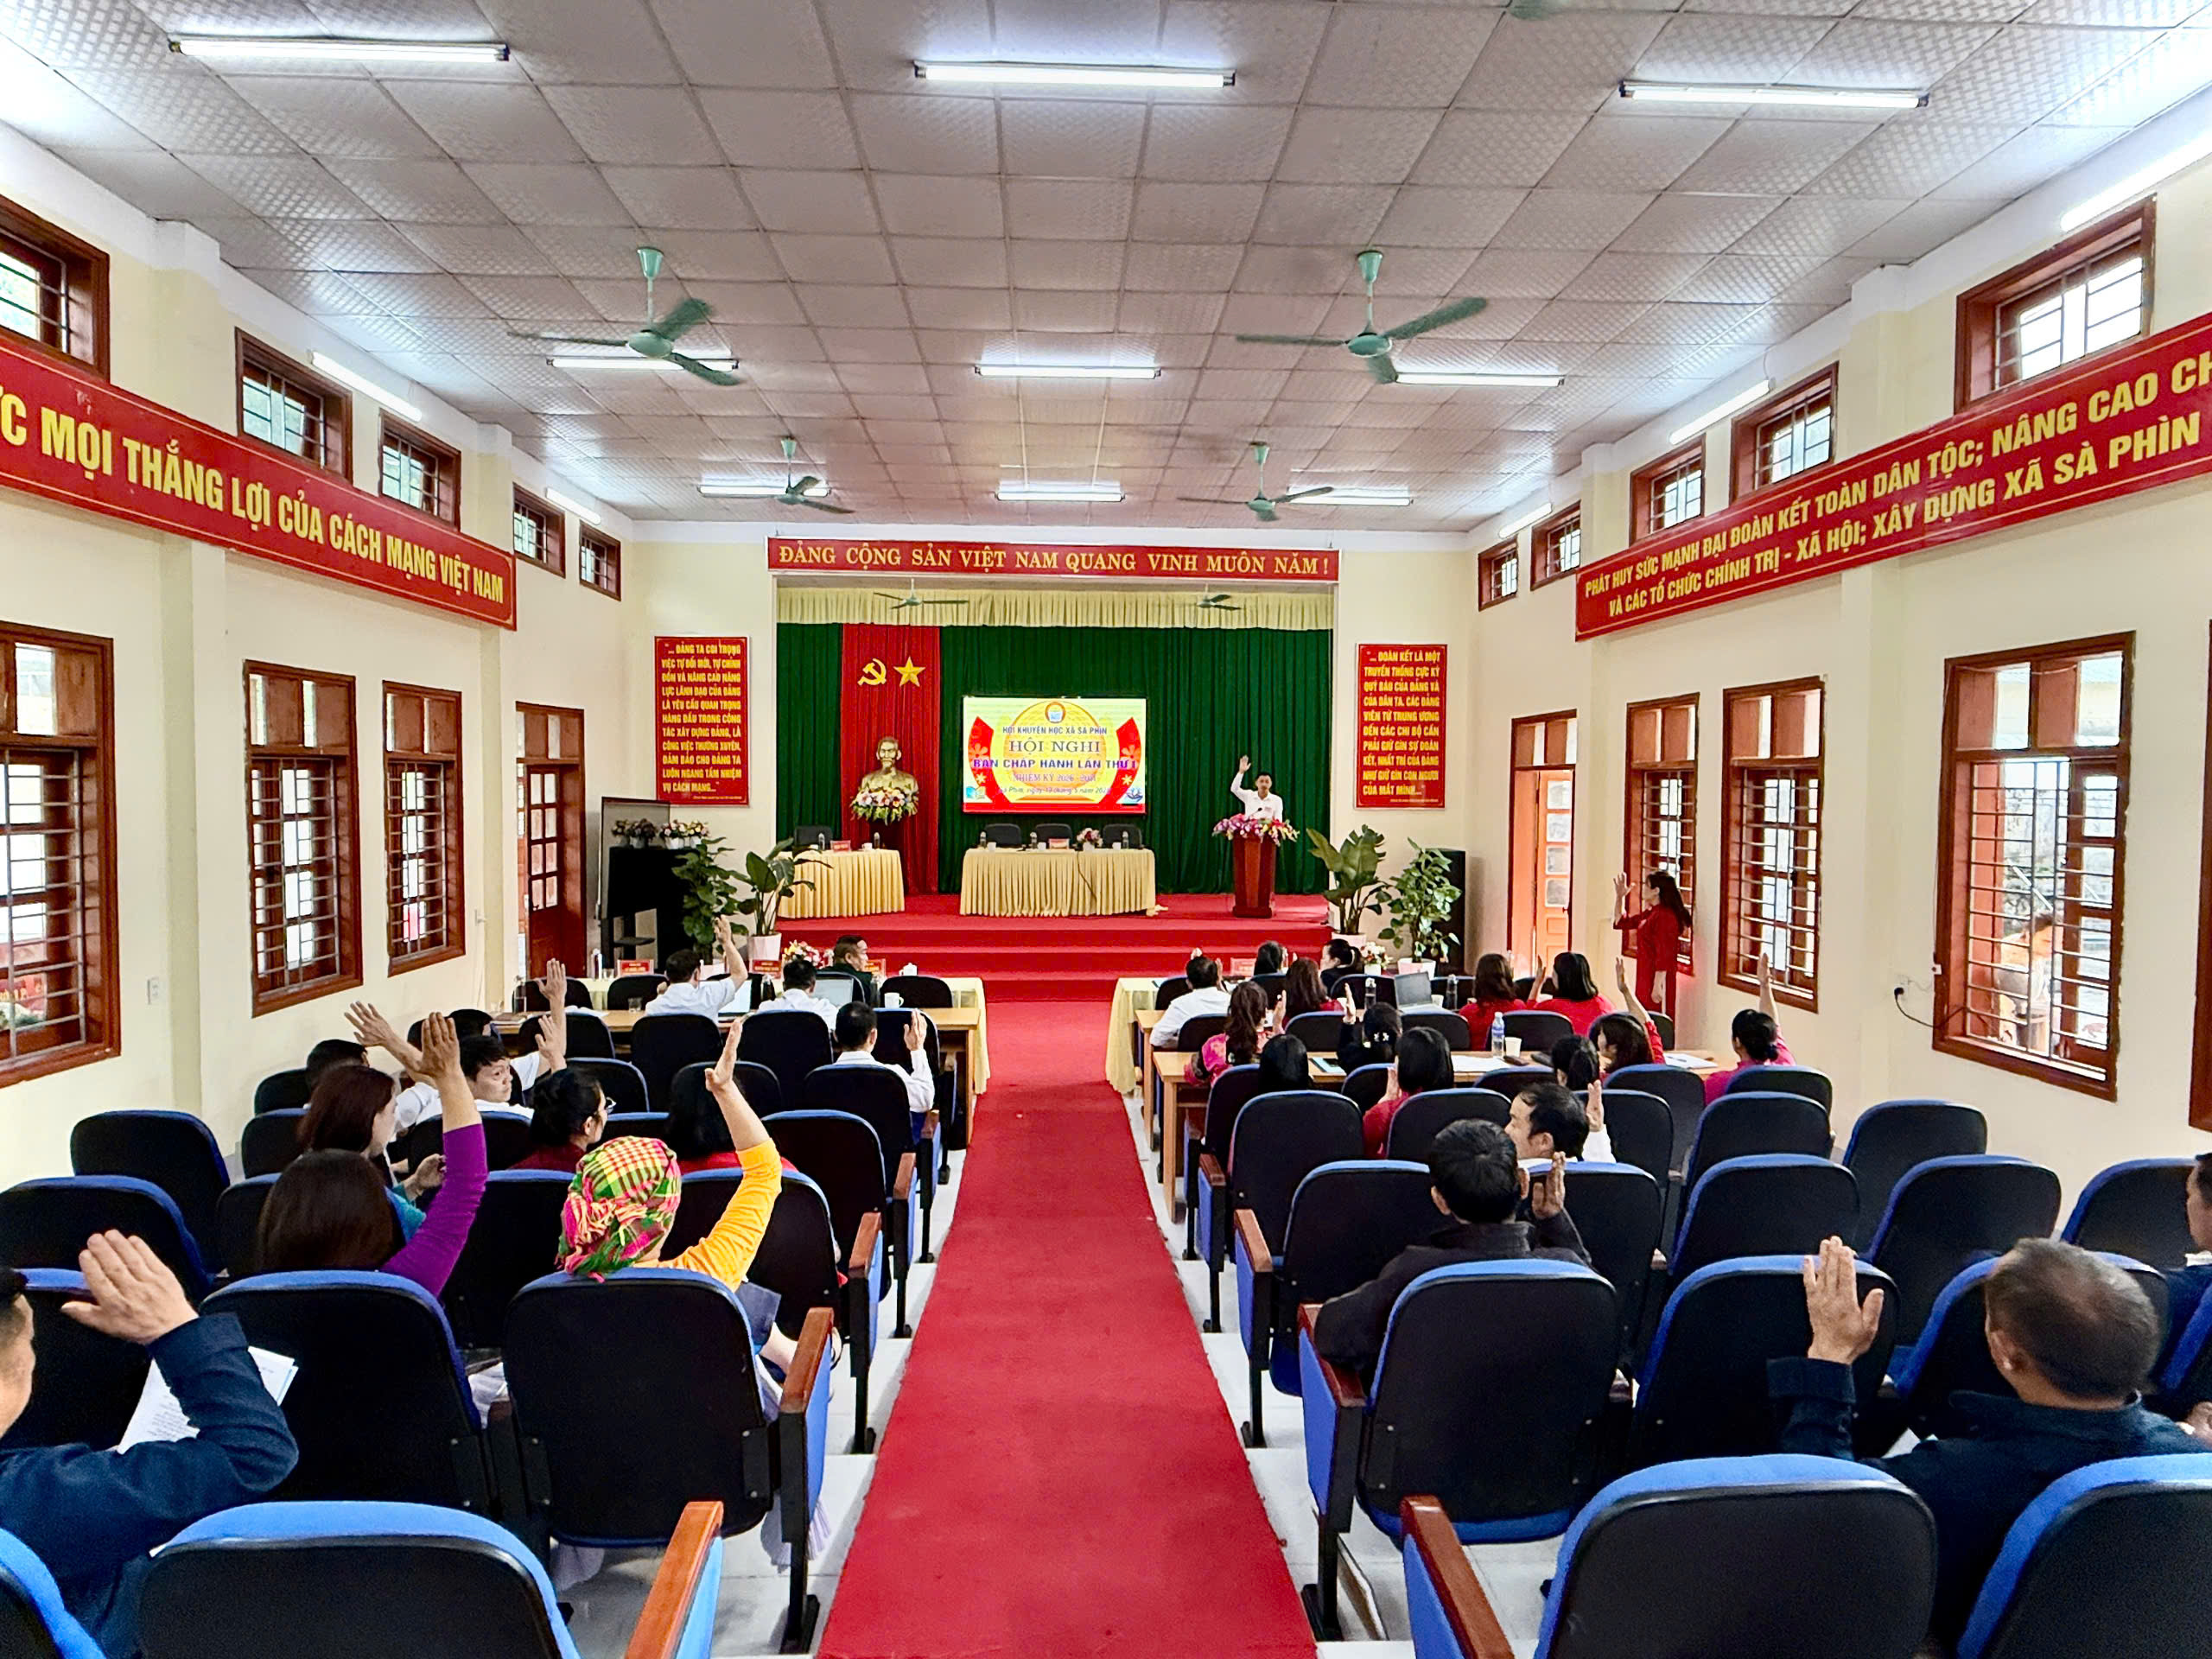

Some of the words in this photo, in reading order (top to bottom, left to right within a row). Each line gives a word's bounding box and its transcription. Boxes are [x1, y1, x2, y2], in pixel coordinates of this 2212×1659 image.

[41, 407, 112, 481] MỌI
[122, 438, 224, 512] THẮNG
[232, 477, 270, 531] LỢI
[278, 489, 324, 544] CỦA
[329, 513, 381, 563] CÁCH
[386, 535, 436, 582] MẠNG
[439, 553, 470, 595] VIỆT
[474, 567, 504, 604] NAM
[1585, 574, 1611, 598] PHÁT
[1612, 564, 1632, 589] HUY
[1636, 556, 1659, 581] SỨC
[1662, 541, 1700, 572] MẠNH
[1702, 531, 1726, 558] ĐẠI
[1731, 513, 1773, 548] ĐOÀN
[1777, 494, 1810, 532] KẾT
[1816, 480, 1867, 518] TOÀN
[1873, 459, 1920, 499] DÂN
[1928, 439, 1984, 479] TỘC;
[1993, 403, 2077, 458] NÂNG
[2088, 372, 2158, 423] CAO
[1609, 594, 1623, 617] VÀ
[1626, 589, 1647, 613] CÁC
[1650, 576, 1665, 604] TỔ
[1668, 573, 1701, 600] CHỨC
[1706, 559, 1751, 588] CHÍNH
[1755, 547, 1780, 574] TRỊ
[1796, 531, 1821, 562] XÃ
[1827, 519, 1866, 552] HỘI;
[1872, 502, 1917, 539] XÂY
[1923, 479, 1995, 523] DỰNG
[2004, 457, 2044, 500] XÃ
[2053, 441, 2098, 484] SÀ
[2108, 411, 2200, 469] PHÌN
[779, 540, 836, 564] ĐẢNG
[846, 543, 901, 570] CỘNG
[912, 543, 951, 567] SẢN
[959, 545, 1006, 573] VIỆT
[1014, 551, 1058, 569] NAM
[1065, 552, 1136, 573] QUANG
[1147, 553, 1198, 572] VINH
[1206, 550, 1265, 574] MUÔN
[1274, 552, 1318, 574] NĂM
[973, 759, 999, 768] BAN
[1009, 737, 1044, 755] HỘI
[1052, 741, 1099, 755] NGHỊ
